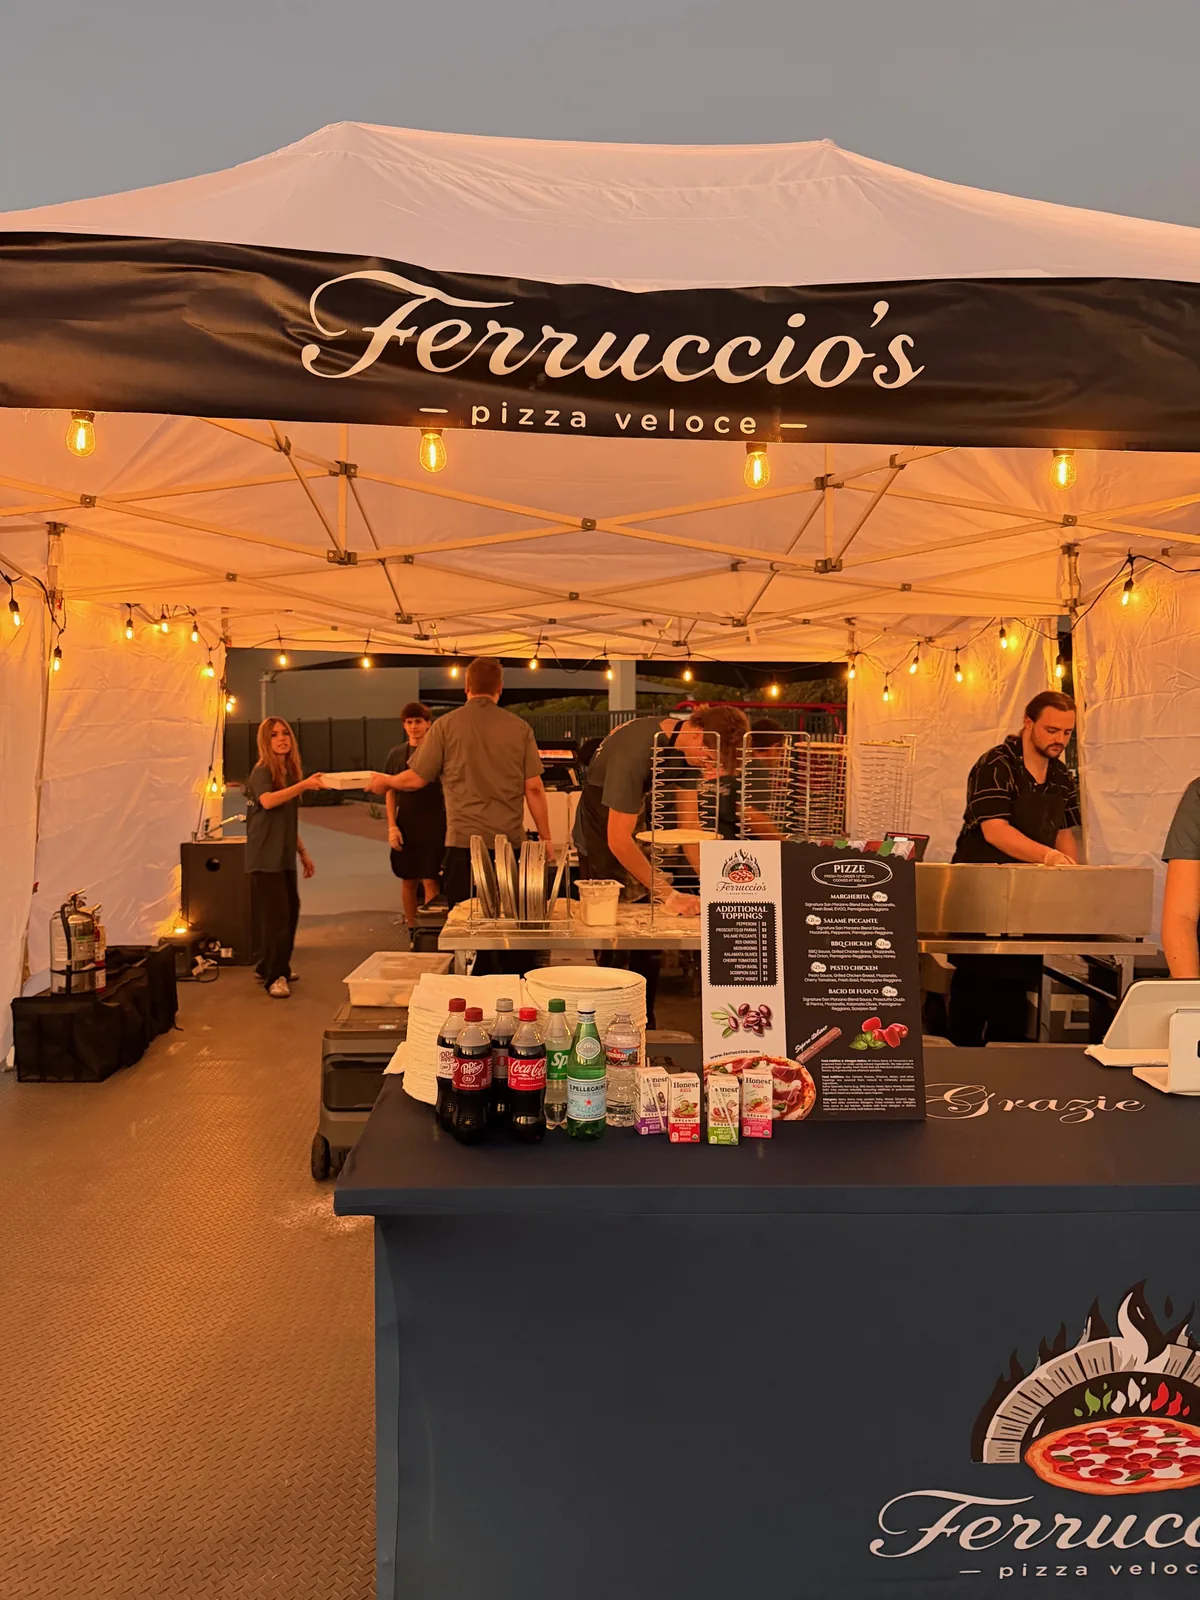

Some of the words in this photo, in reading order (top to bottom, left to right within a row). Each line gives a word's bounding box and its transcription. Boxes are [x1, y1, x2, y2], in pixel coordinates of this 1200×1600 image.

[301, 270, 925, 389] Ferruccio's
[471, 402, 588, 430] pizza
[615, 408, 758, 435] veloce
[833, 864, 866, 873] PIZZE
[716, 881, 767, 892] Ferruccio's
[745, 1077, 771, 1085] Honest
[925, 1083, 1145, 1124] Grazie
[999, 1563, 1088, 1579] pizza
